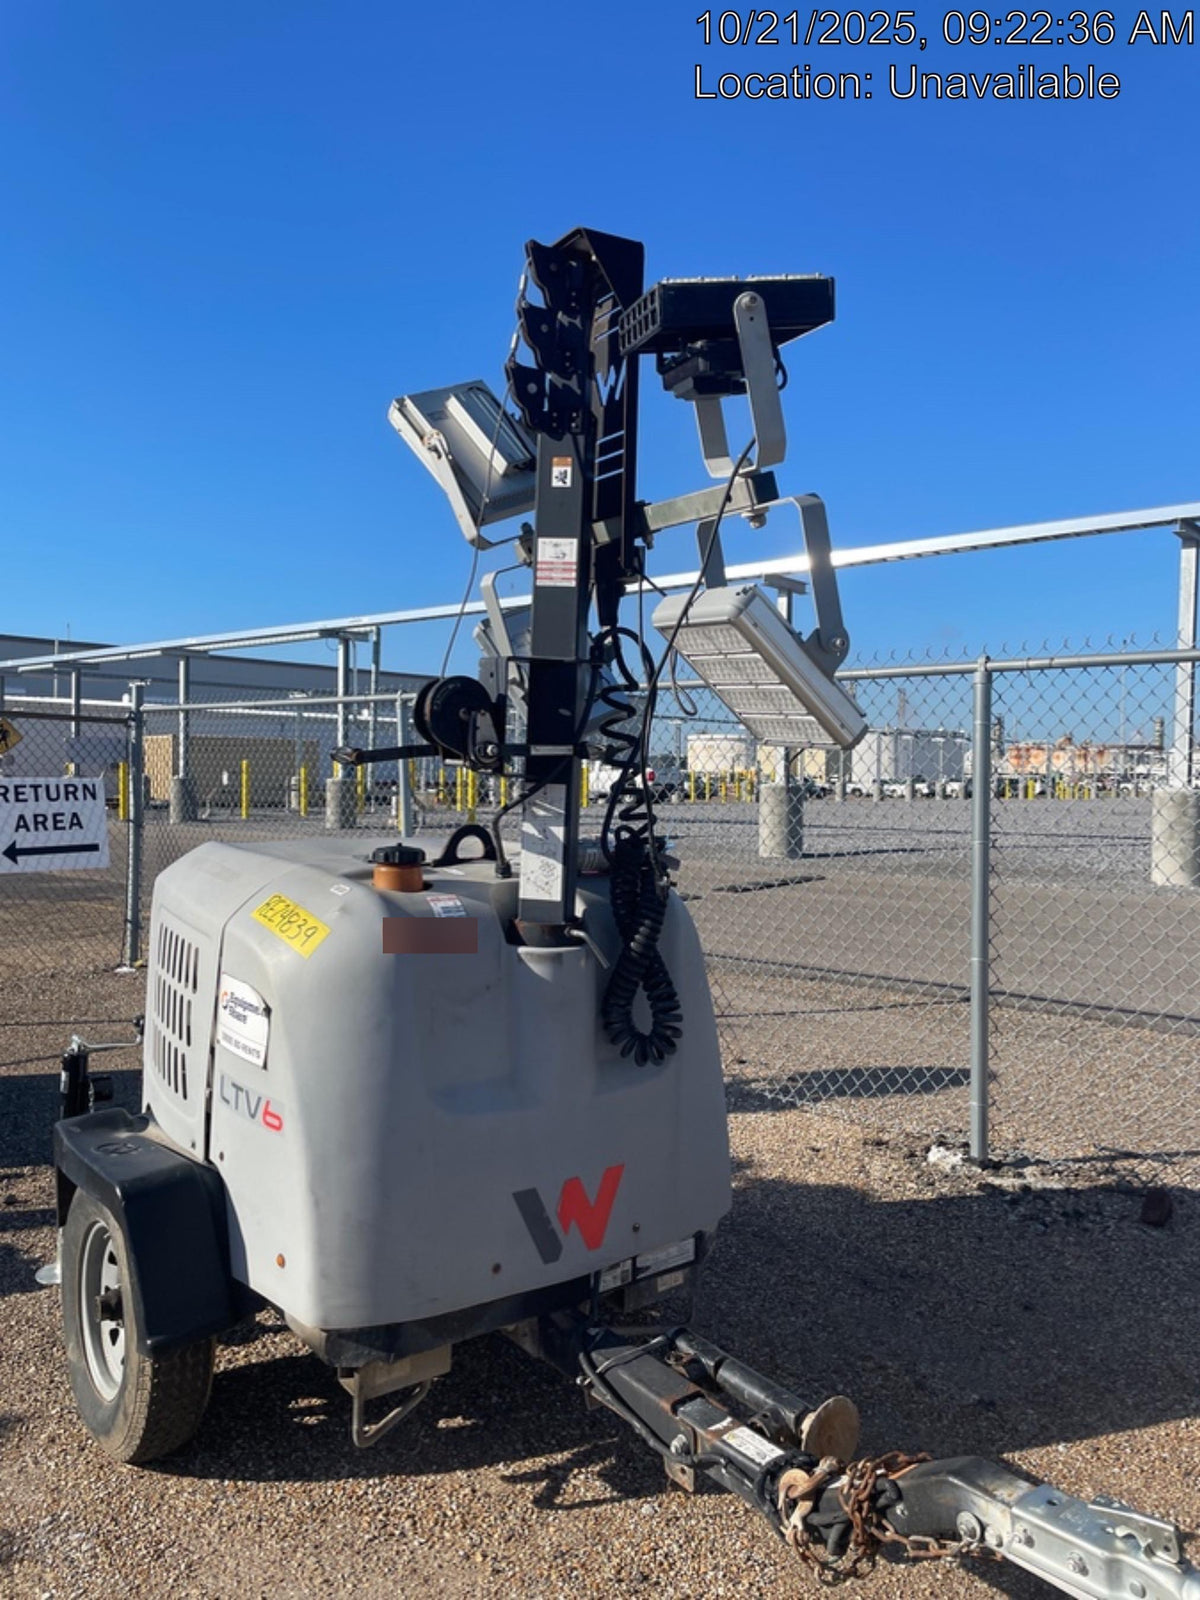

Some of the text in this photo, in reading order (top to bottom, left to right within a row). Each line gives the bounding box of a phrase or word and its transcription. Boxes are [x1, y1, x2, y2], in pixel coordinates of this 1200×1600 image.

[0, 784, 97, 803] RETURN
[15, 812, 84, 833] AREA
[219, 1074, 284, 1132] LTV6
